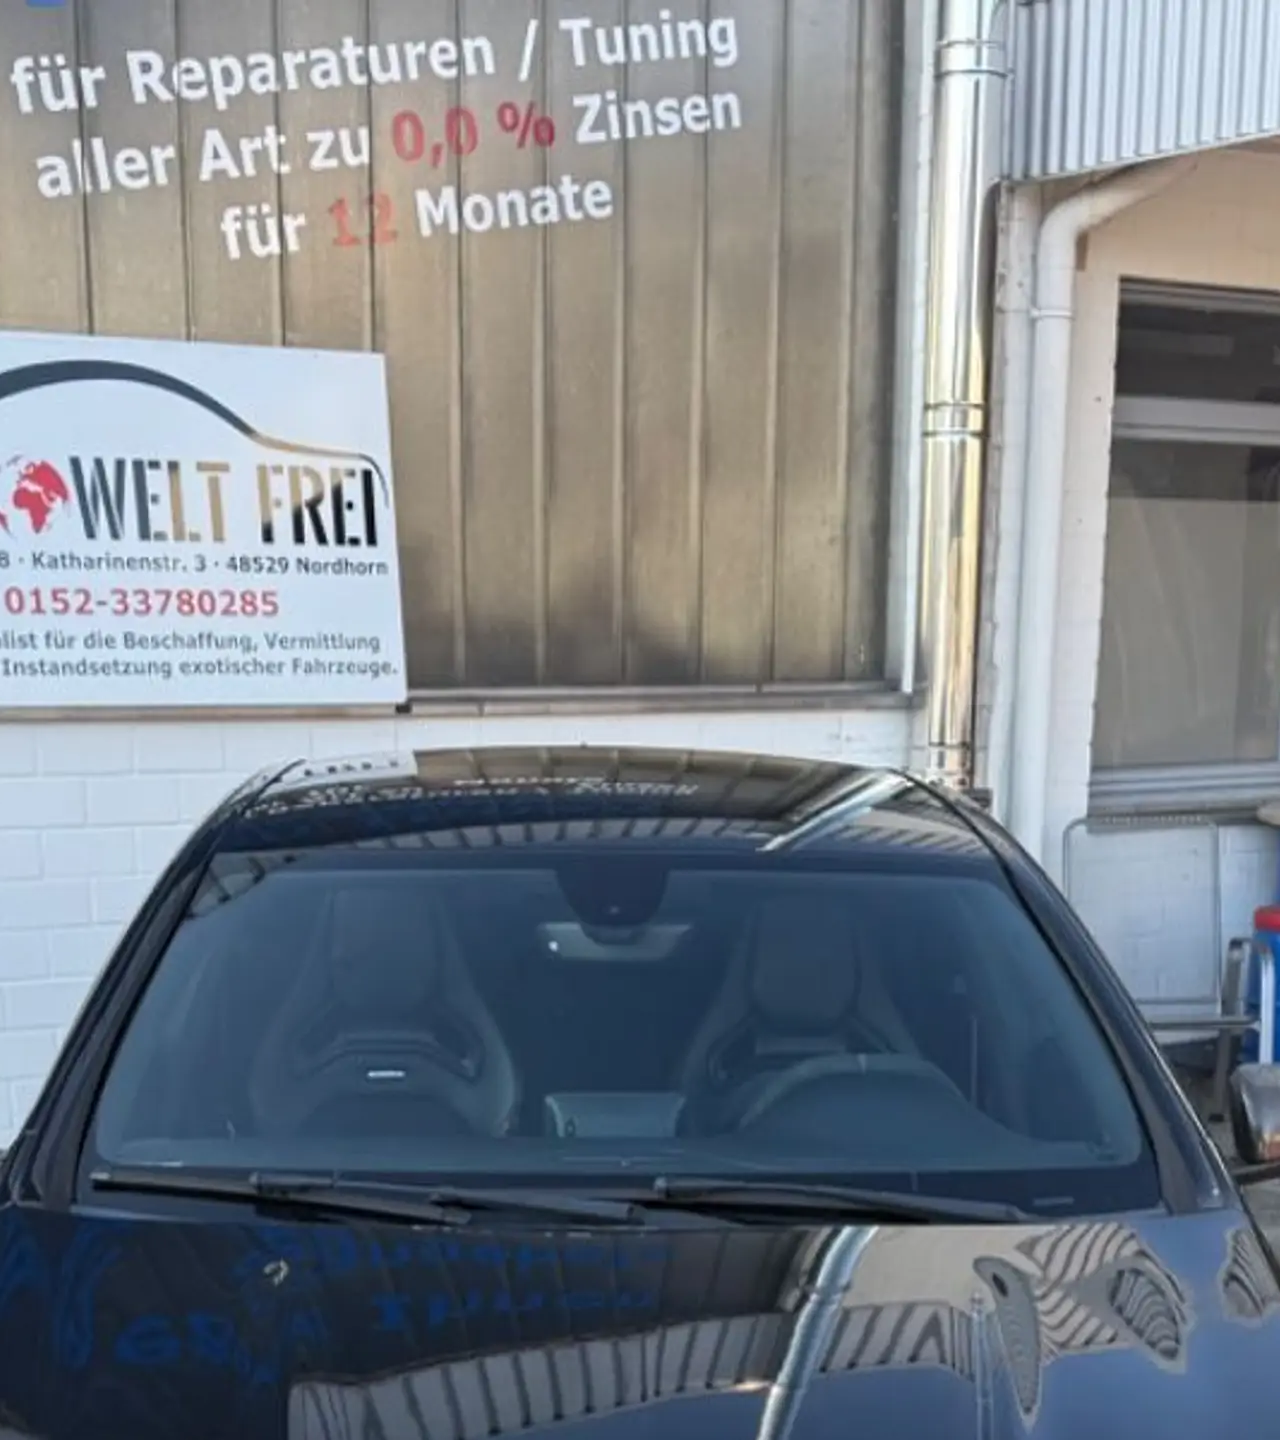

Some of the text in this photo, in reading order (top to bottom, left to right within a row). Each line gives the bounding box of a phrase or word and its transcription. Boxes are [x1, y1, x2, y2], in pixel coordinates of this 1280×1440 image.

[10, 11, 739, 114] für Reparaturen / Tuning
[36, 140, 176, 198] aller
[199, 126, 291, 184] Art
[308, 123, 372, 171] zu
[391, 108, 480, 170] 0,0
[573, 89, 742, 144] Zinsen
[221, 173, 613, 261] für 12 Monate
[256, 463, 379, 547] FREI
[32, 550, 188, 573] Katharinenstr.
[194, 554, 206, 572] 3
[226, 555, 290, 574] 48529
[296, 556, 388, 576] Nordhorn
[4, 586, 280, 618] 0152-33780285
[1, 658, 172, 682] Instandsetzung
[179, 658, 284, 678] exotischer
[292, 660, 398, 683] Fahrzeuge.
[44, 631, 77, 651] für
[84, 632, 117, 651] die
[123, 631, 258, 656] Beschaffung,
[265, 632, 380, 656] Vermittlung
